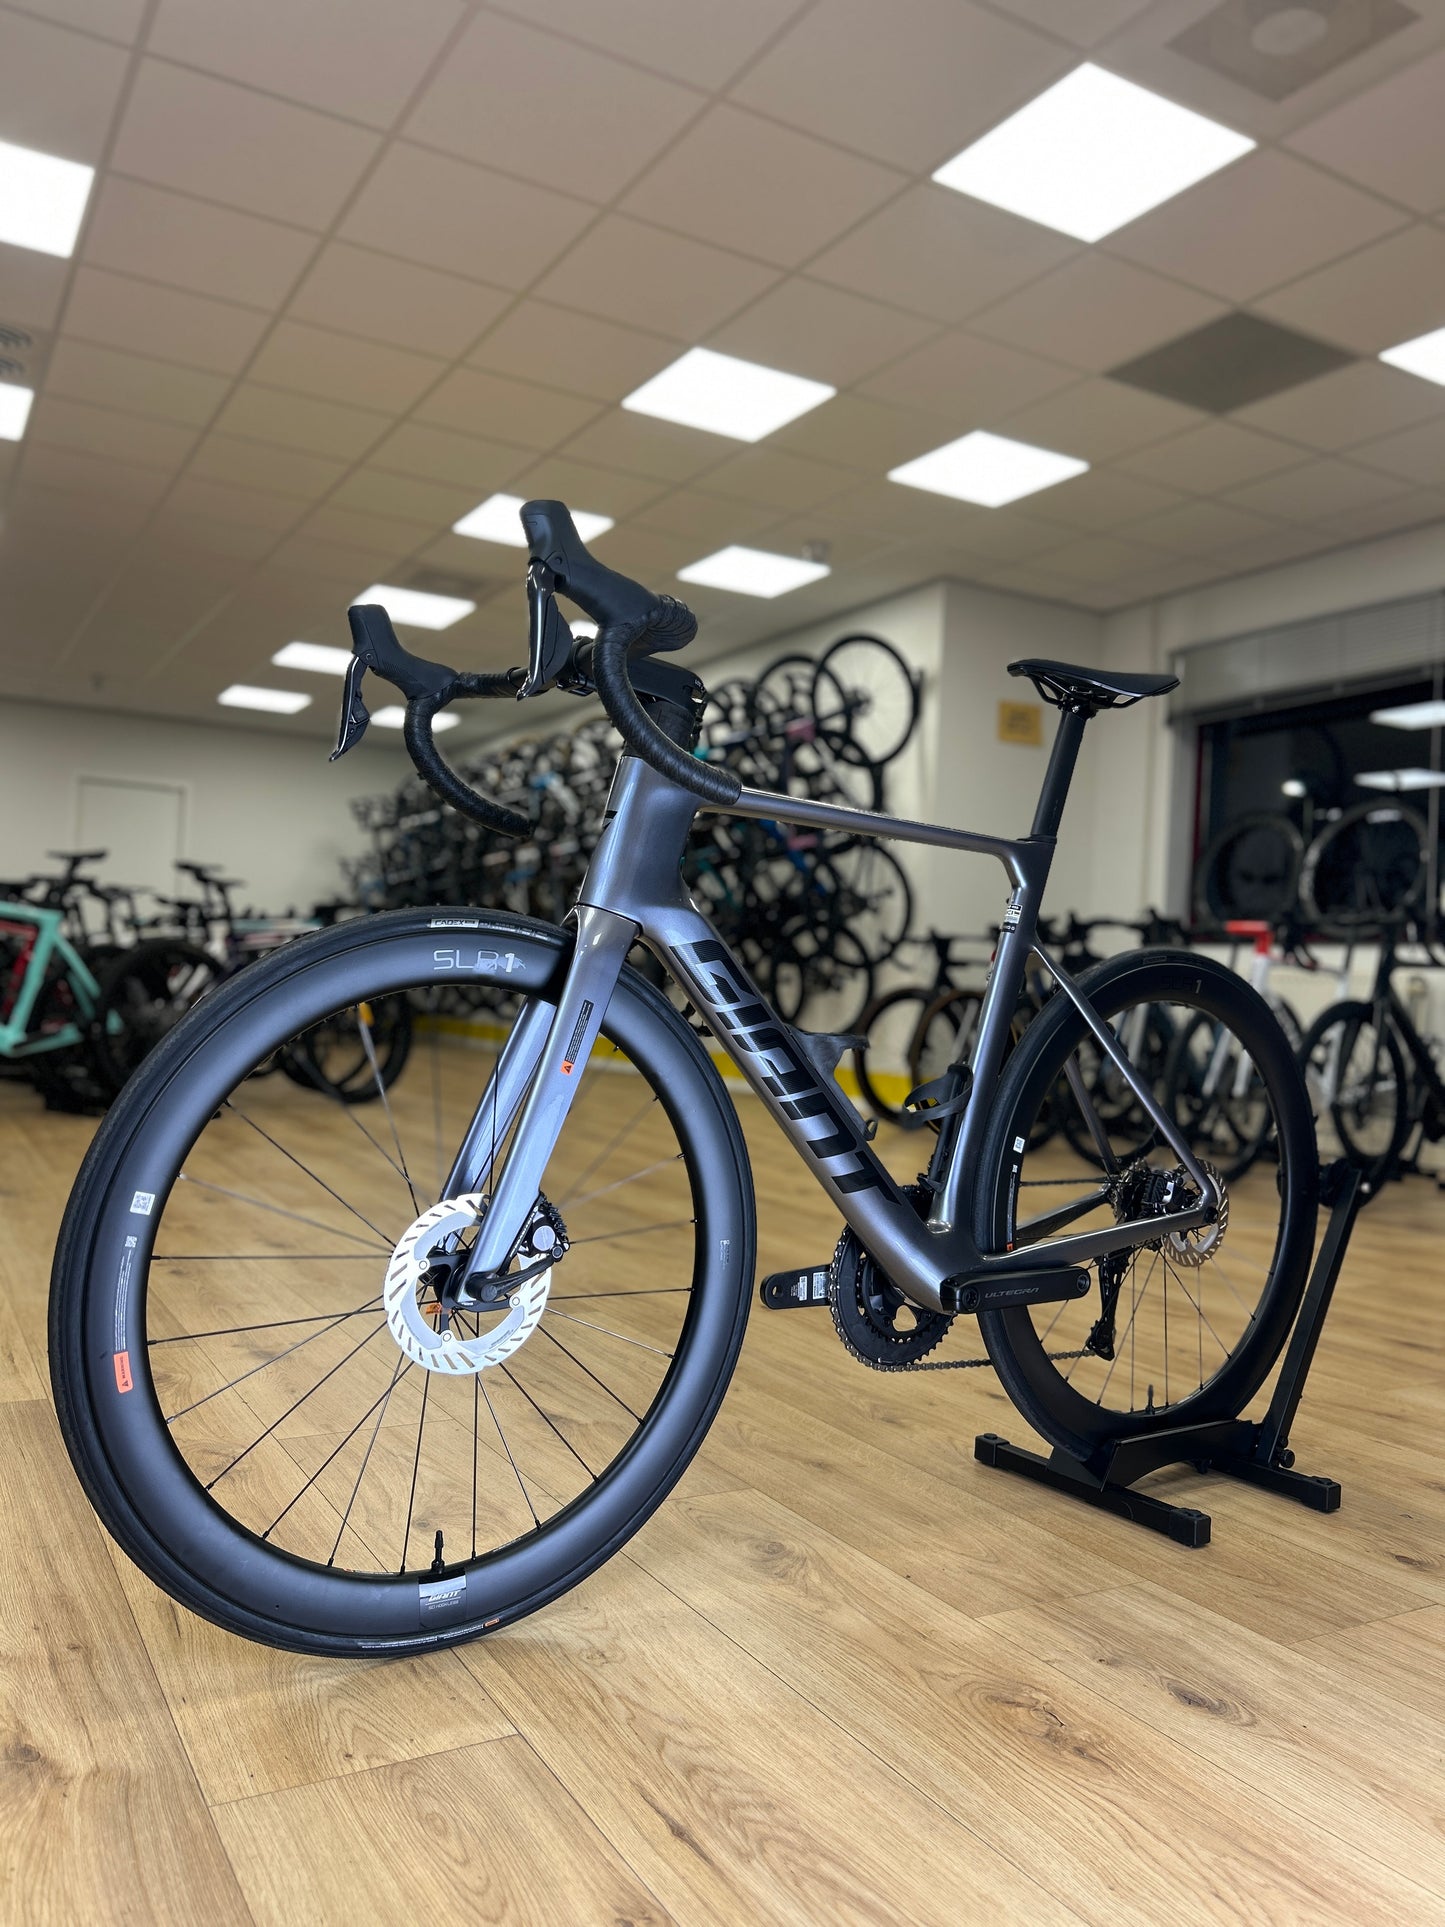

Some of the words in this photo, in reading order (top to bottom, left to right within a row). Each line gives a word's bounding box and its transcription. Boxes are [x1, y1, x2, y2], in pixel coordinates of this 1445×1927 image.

[434, 919, 465, 927] CADEX
[669, 939, 902, 1206] GIANT
[985, 1287, 1040, 1299] ULTEGRA
